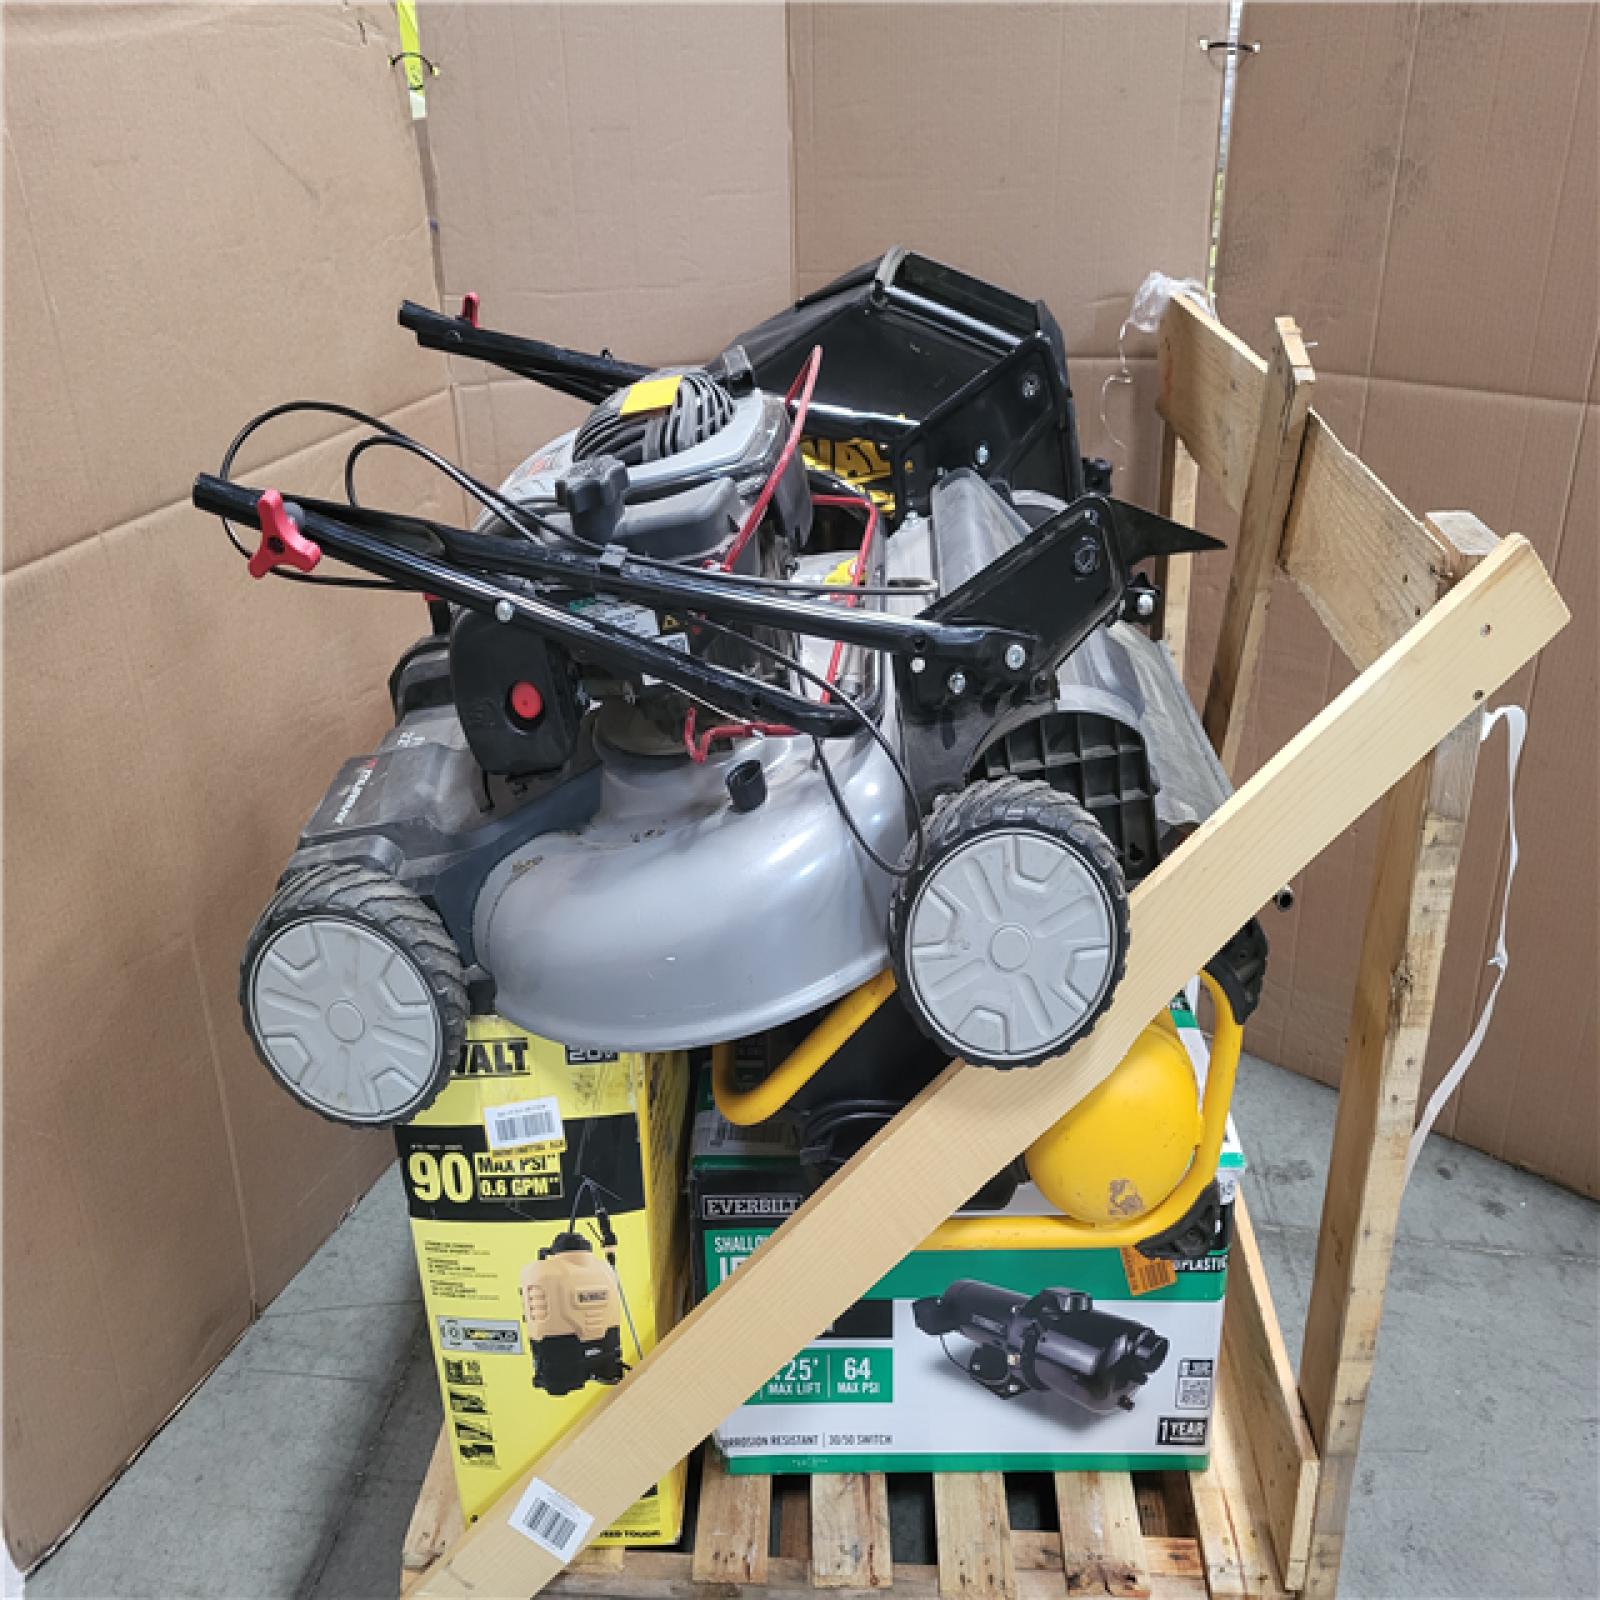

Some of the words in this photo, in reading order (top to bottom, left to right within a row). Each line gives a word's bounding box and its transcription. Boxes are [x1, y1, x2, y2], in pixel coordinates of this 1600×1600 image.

[408, 1152, 474, 1203] 90
[706, 1198, 800, 1214] EVERBILT
[714, 1234, 771, 1254] SHALLO
[844, 1356, 872, 1381] 64
[768, 1382, 793, 1395] MAX
[796, 1381, 822, 1395] LIFT
[837, 1382, 859, 1394] MAX
[861, 1382, 880, 1394] PSI
[770, 1434, 819, 1446] RESISTANT
[857, 1434, 894, 1446] SWITCH
